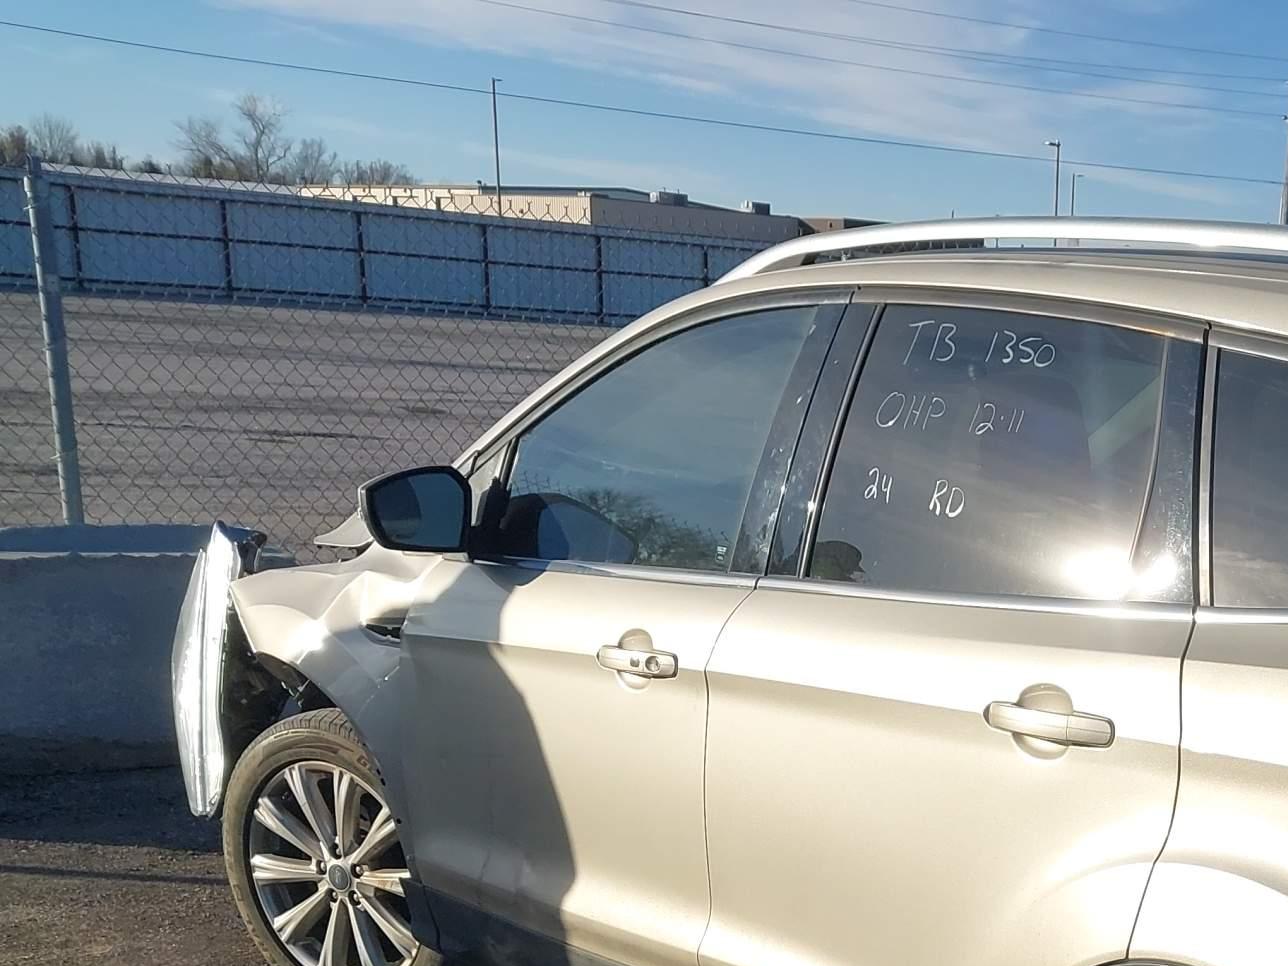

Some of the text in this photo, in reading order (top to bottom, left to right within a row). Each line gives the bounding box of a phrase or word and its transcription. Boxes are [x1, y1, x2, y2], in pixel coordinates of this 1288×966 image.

[903, 320, 1056, 367] TB 1350
[875, 391, 946, 431] OHP
[863, 466, 965, 518] 24 RD
